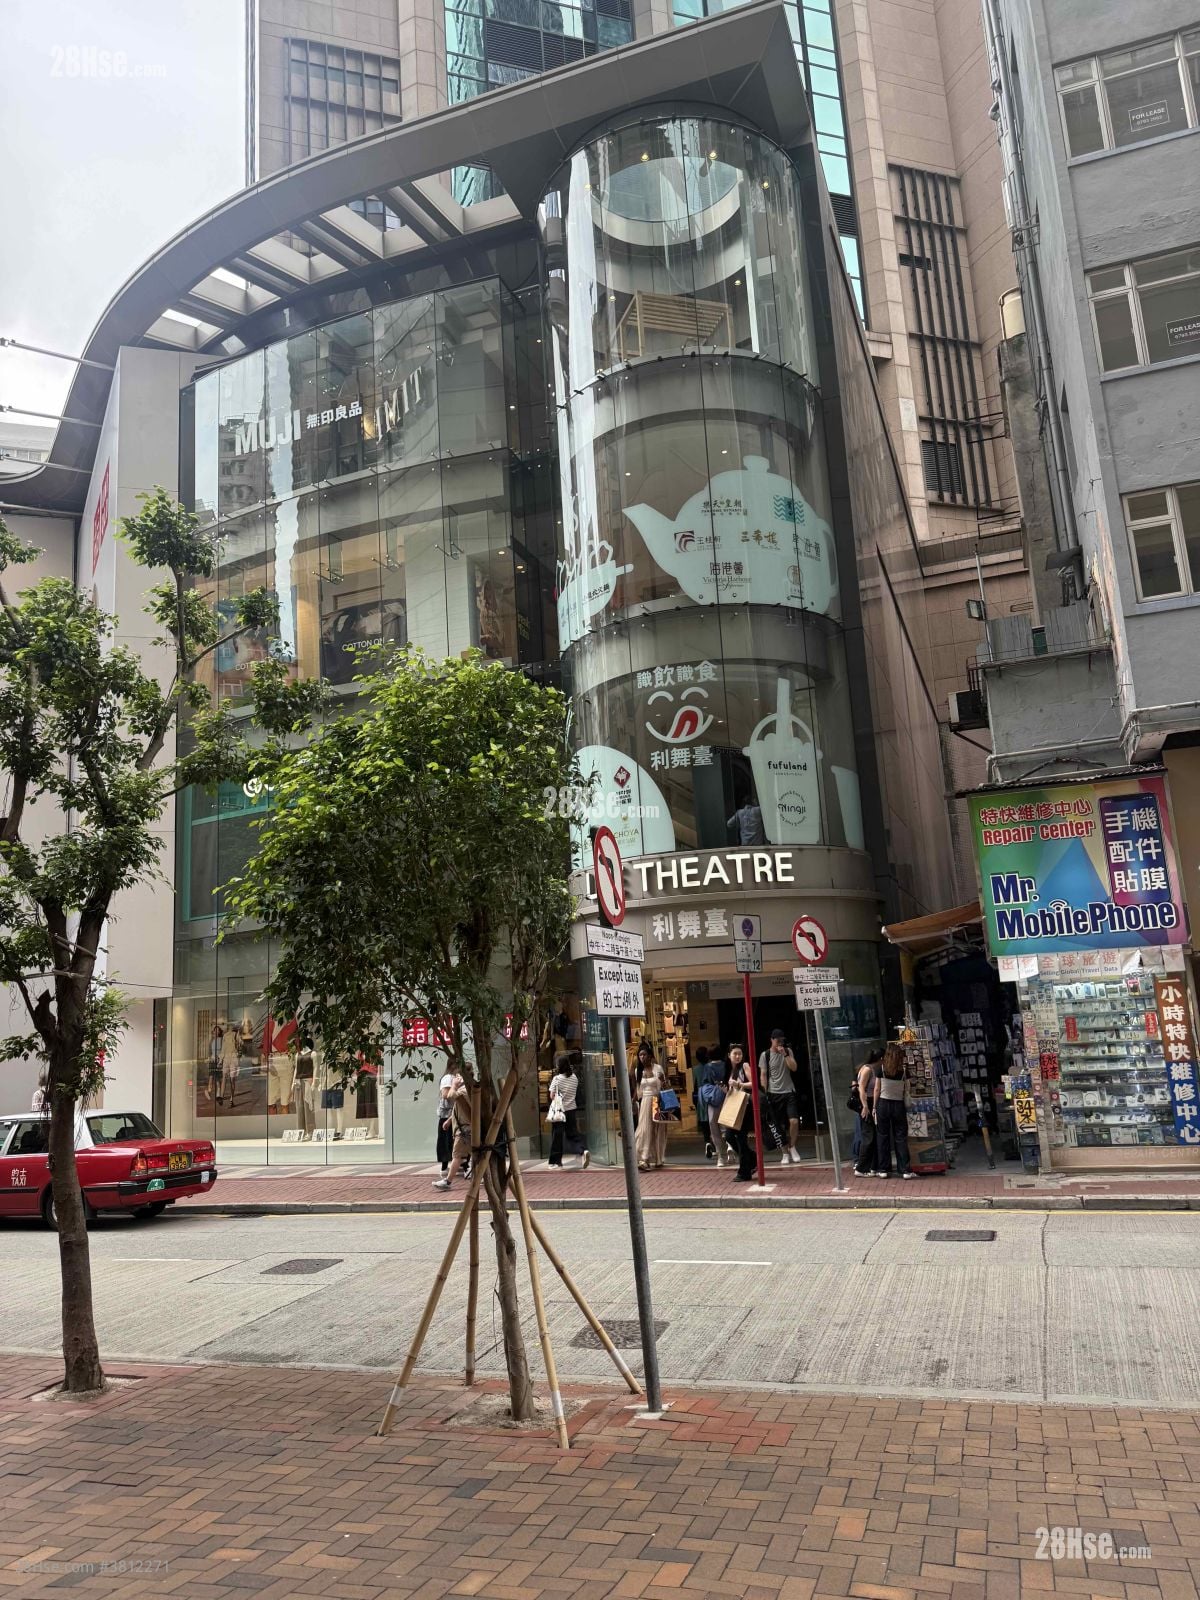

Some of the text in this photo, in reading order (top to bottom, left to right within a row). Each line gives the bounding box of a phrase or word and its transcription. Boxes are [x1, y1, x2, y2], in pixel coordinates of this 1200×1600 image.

[1132, 113, 1146, 121] FOR
[1146, 107, 1166, 117] LEASE
[306, 400, 363, 429] 無印良品
[235, 409, 302, 456] MUJI
[342, 637, 385, 652] COTTON ON
[636, 660, 719, 689] 識飲識食
[650, 745, 714, 771] 利舞臺
[768, 760, 807, 771] fufuland
[980, 797, 1093, 825] 特快維修中心
[1104, 807, 1158, 834] 手機
[614, 828, 639, 839] CHOYA
[982, 824, 1037, 846] Repair
[1108, 837, 1162, 863] 配件
[633, 852, 795, 892] THEATRE
[1114, 867, 1168, 893] 貼膜
[990, 872, 1041, 905] Mr.
[652, 908, 729, 942] 利舞臺
[752, 942, 756, 953] 7
[752, 959, 761, 970] 12
[1060, 968, 1080, 976] Global
[598, 966, 639, 984] Except taxis
[799, 985, 836, 994] Except taxis
[602, 990, 640, 1010] 的士例外
[803, 996, 835, 1008] 的士例外
[1116, 1148, 1156, 1160] REPAIR
[11, 1168, 27, 1177] 的士
[11, 1177, 27, 1187] TAXI
